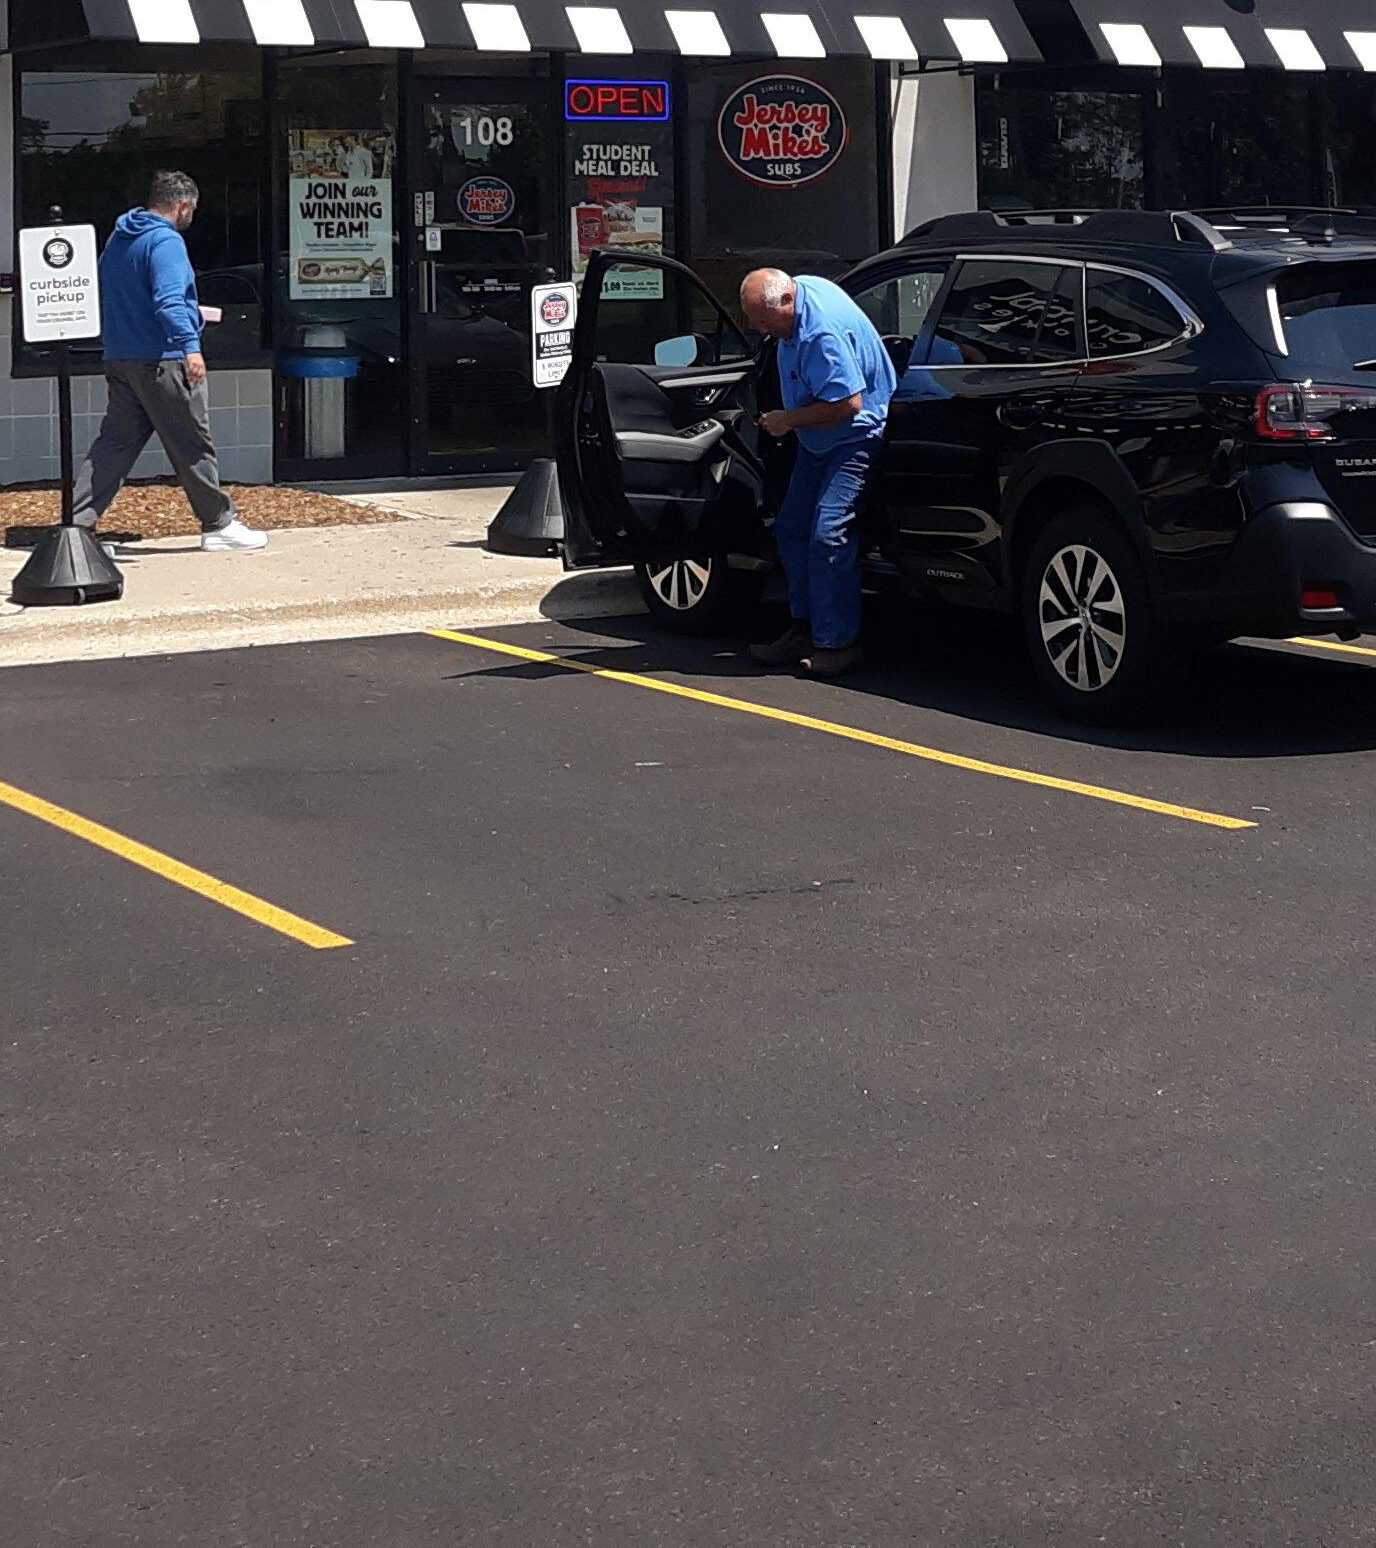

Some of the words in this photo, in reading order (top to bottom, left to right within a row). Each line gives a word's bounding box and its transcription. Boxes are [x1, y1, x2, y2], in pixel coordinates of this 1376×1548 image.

[570, 85, 664, 114] OPEN
[734, 94, 831, 134] Jersey
[460, 116, 514, 146] 108
[582, 144, 652, 161] STUDENT
[740, 126, 830, 161] Mike's
[574, 159, 616, 177] MEAL
[620, 160, 659, 177] DEAL
[766, 162, 802, 177] SUBS
[305, 182, 347, 200] JOIN
[351, 184, 379, 198] our
[464, 184, 508, 201] Jersey
[299, 201, 383, 220] WINNING
[314, 221, 370, 239] TEAM!
[30, 275, 91, 291] curbside
[37, 290, 86, 306] pickup
